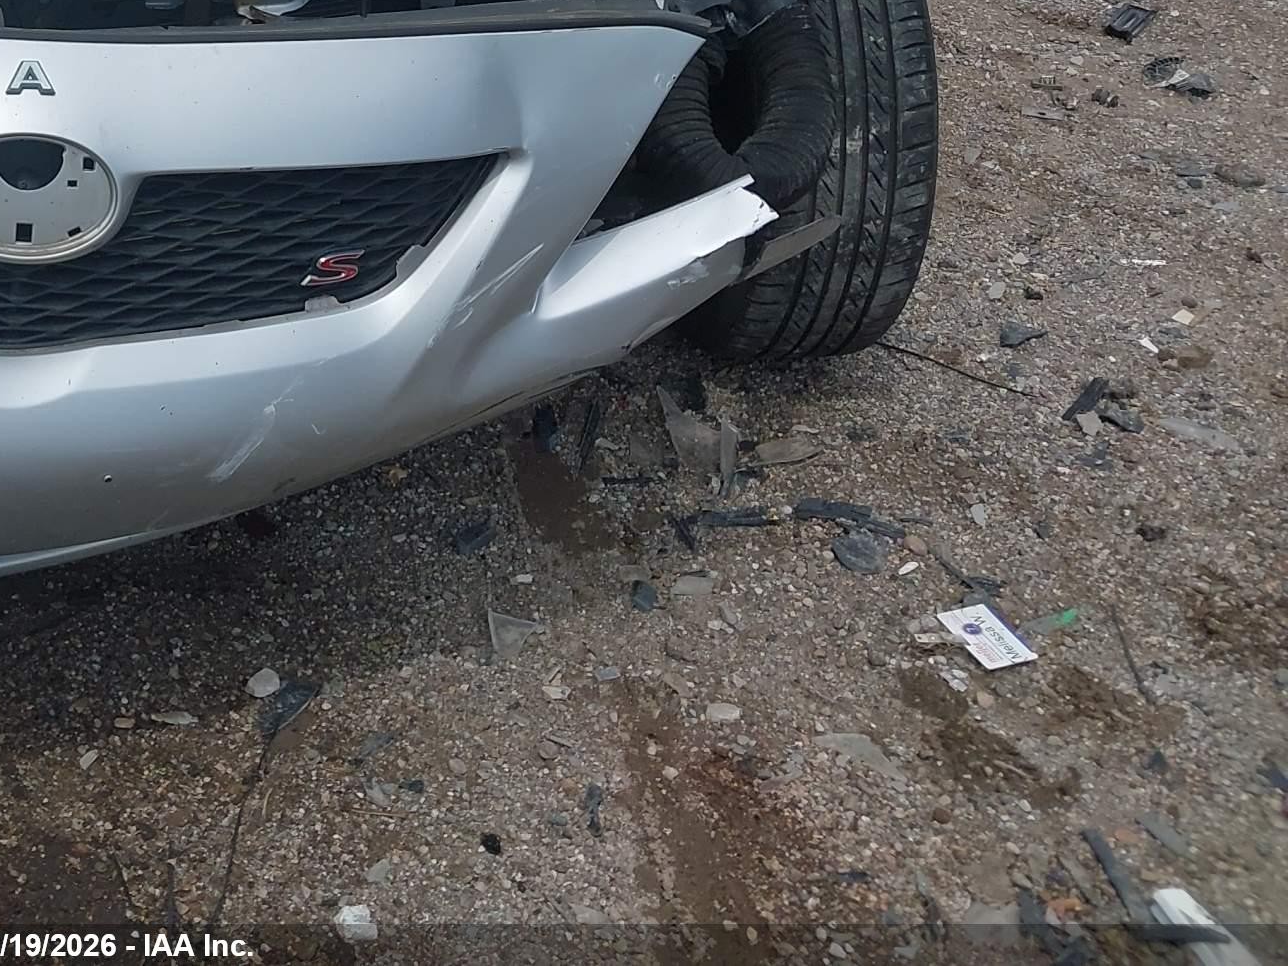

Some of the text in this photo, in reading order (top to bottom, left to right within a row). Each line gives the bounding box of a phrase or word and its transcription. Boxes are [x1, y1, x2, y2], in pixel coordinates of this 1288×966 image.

[5, 59, 56, 96] A
[300, 249, 366, 287] S
[985, 626, 1023, 660] Melissa
